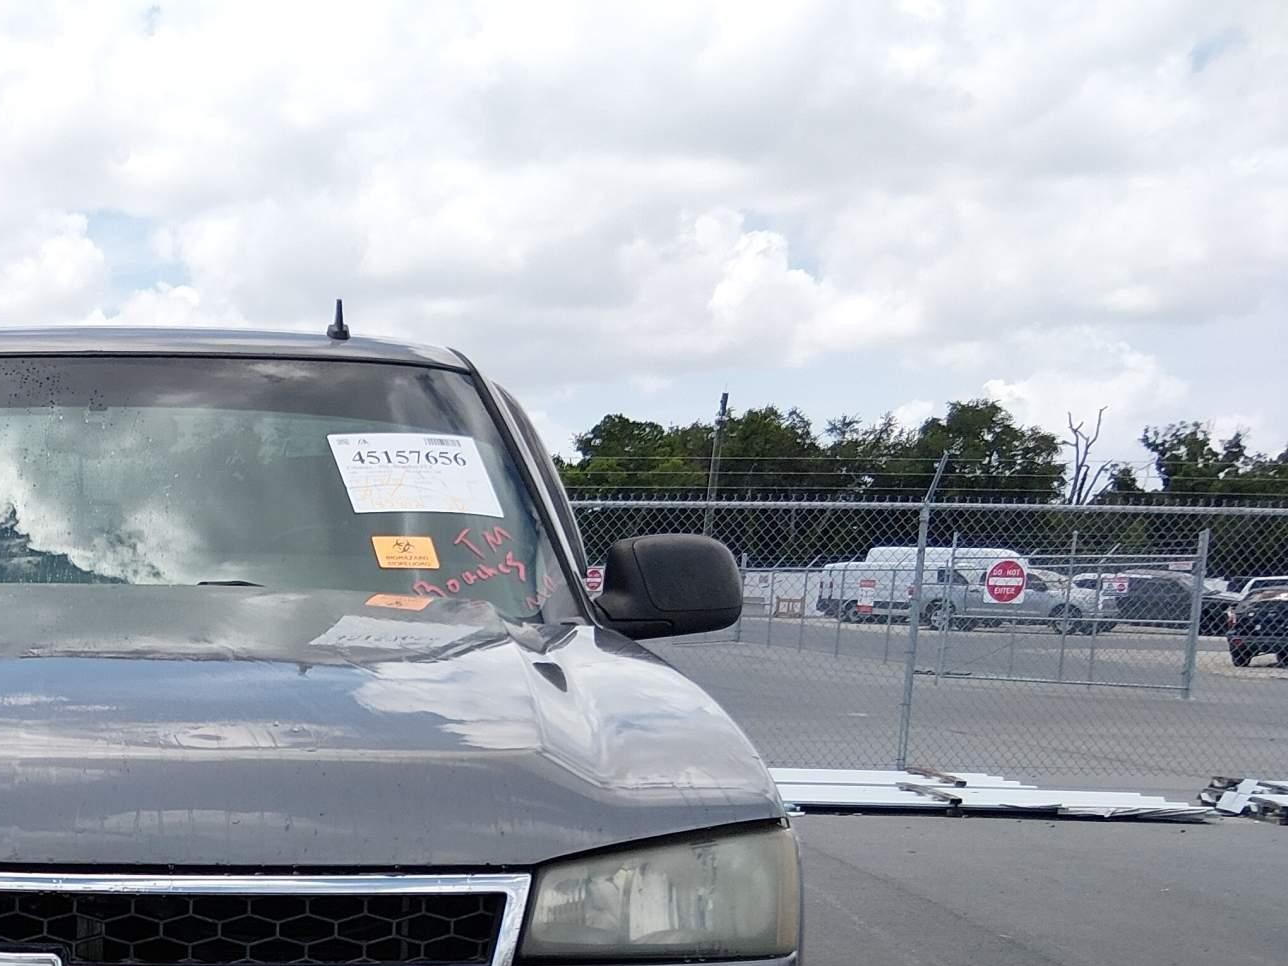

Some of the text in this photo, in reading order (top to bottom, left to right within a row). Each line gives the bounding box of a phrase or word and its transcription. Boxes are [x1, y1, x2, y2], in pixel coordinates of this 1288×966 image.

[352, 450, 467, 467] 45157656
[992, 568, 1021, 577] DO NOT
[994, 587, 1016, 595] ENTER
